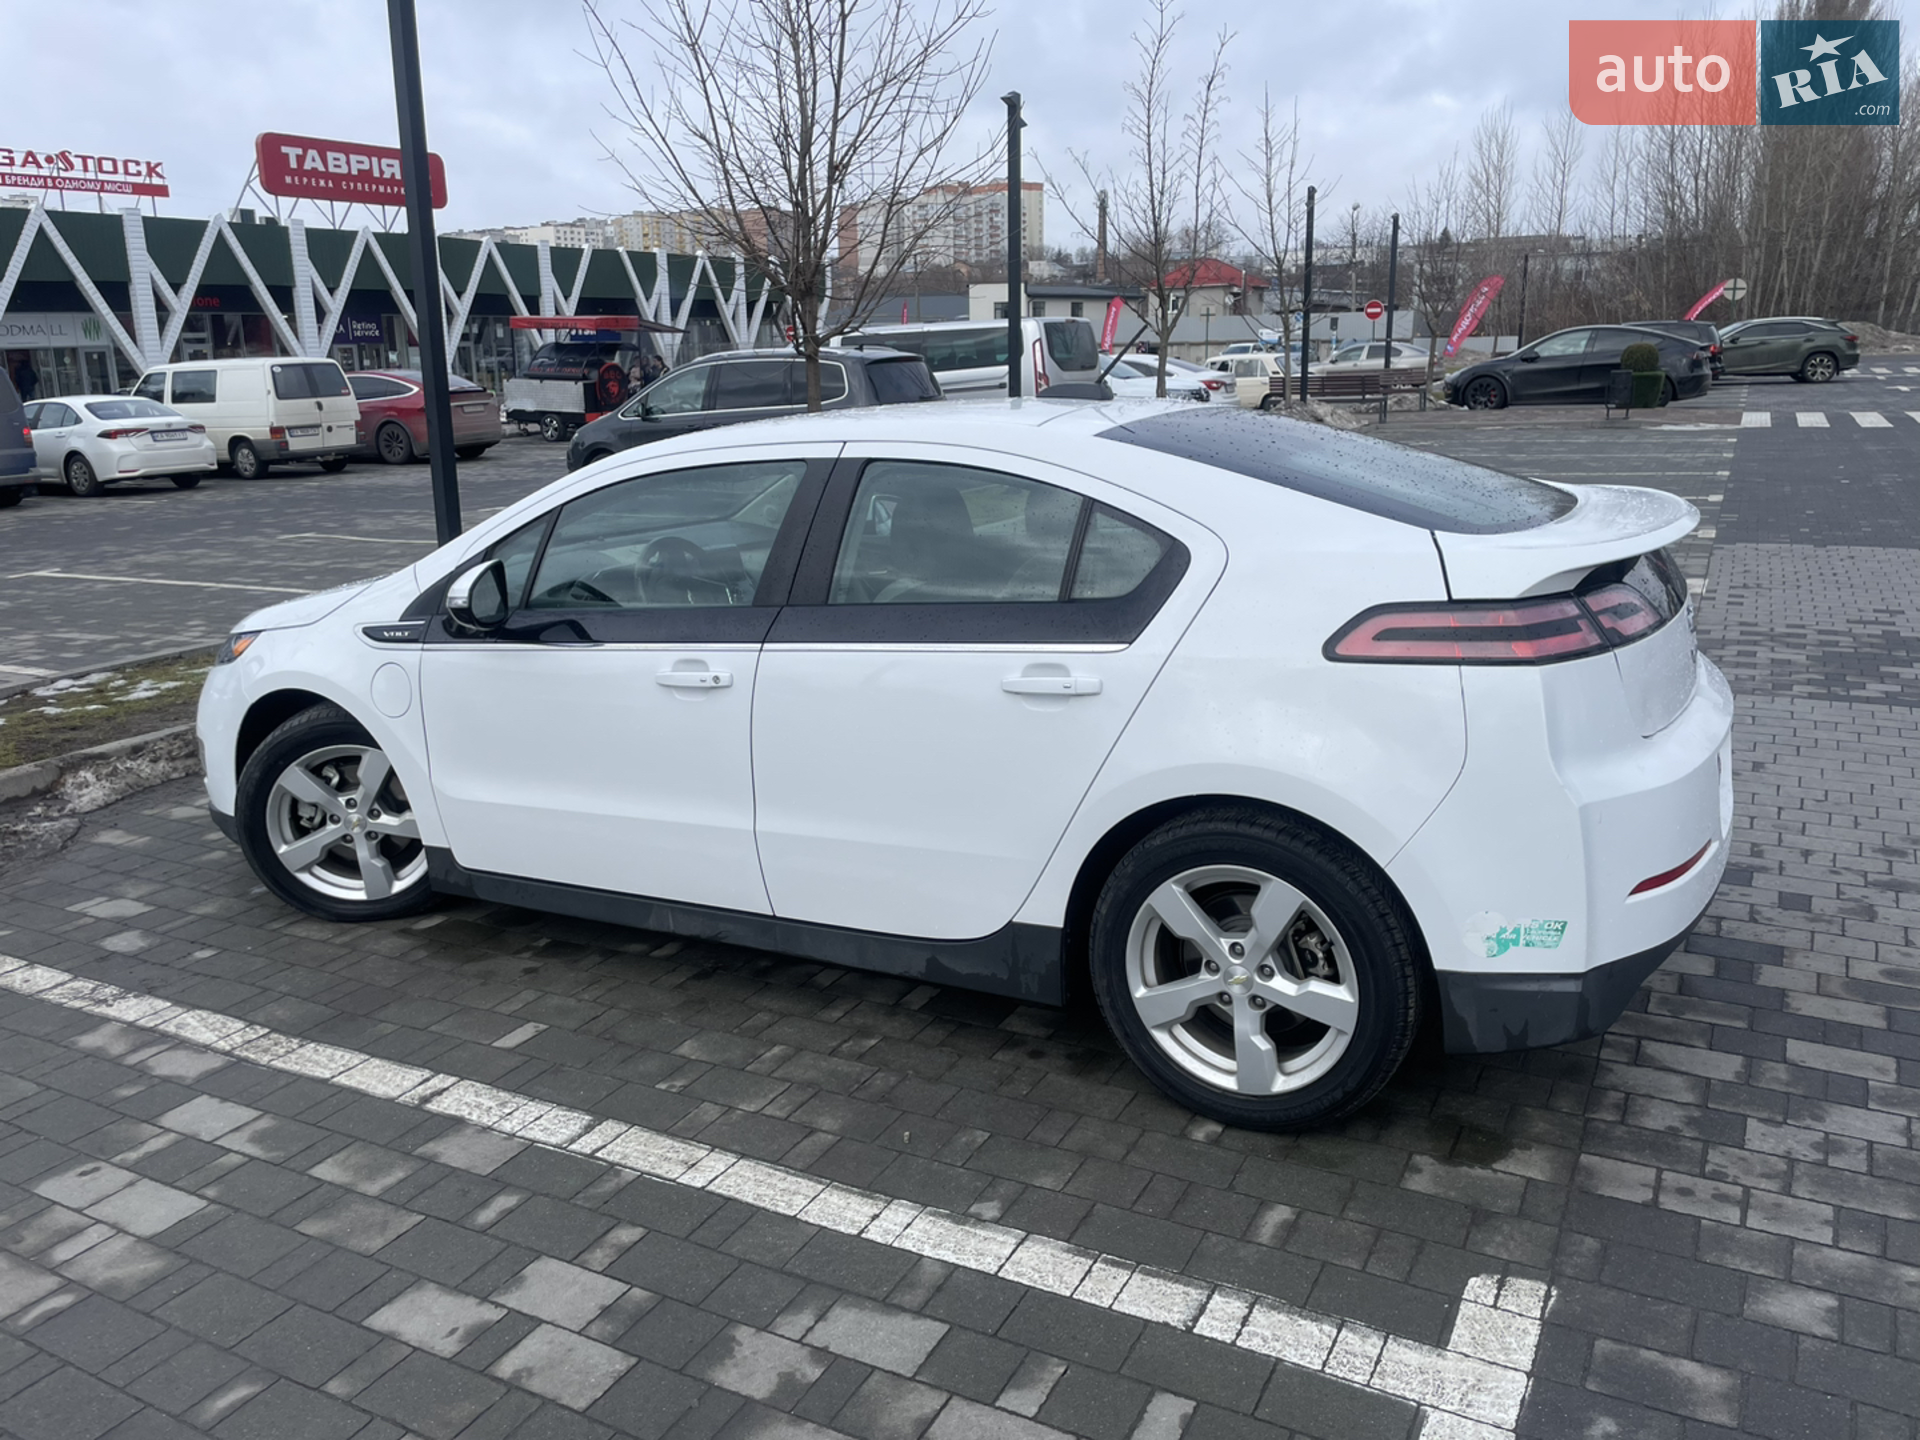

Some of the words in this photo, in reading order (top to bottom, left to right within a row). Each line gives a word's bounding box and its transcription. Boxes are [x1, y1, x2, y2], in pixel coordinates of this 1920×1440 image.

[57, 150, 167, 180] STOCK
[280, 145, 402, 180] ТАВРІЯ
[5, 174, 45, 188] БРЕНДИ
[55, 178, 102, 191] ОДНОМУ
[285, 175, 334, 188] МЕРЕЖА
